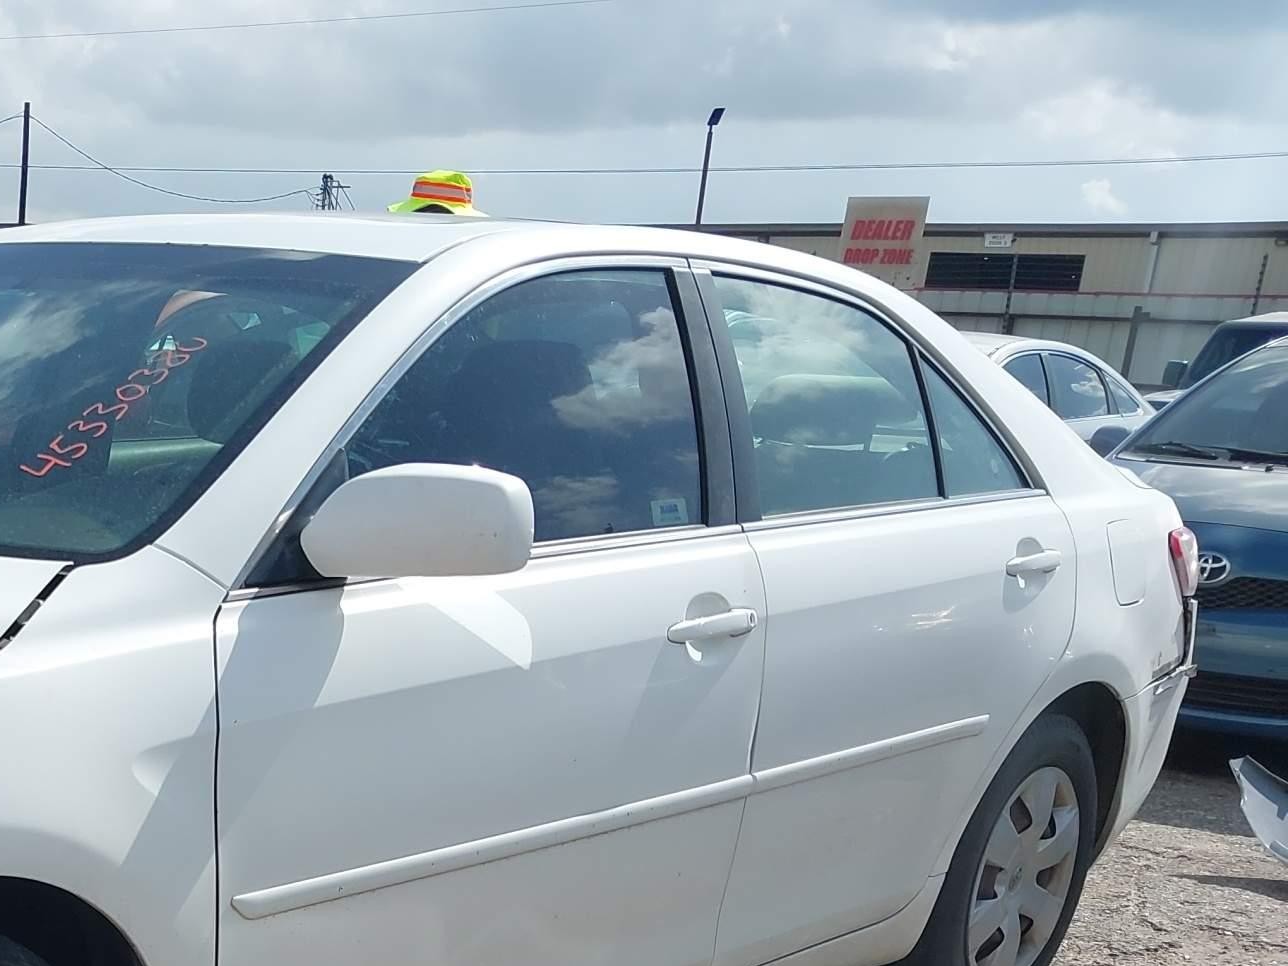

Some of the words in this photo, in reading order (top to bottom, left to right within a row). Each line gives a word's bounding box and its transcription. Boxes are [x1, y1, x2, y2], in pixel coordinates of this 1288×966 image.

[850, 219, 915, 241] DEALER
[843, 247, 880, 264] DROP
[879, 248, 914, 264] ZONE
